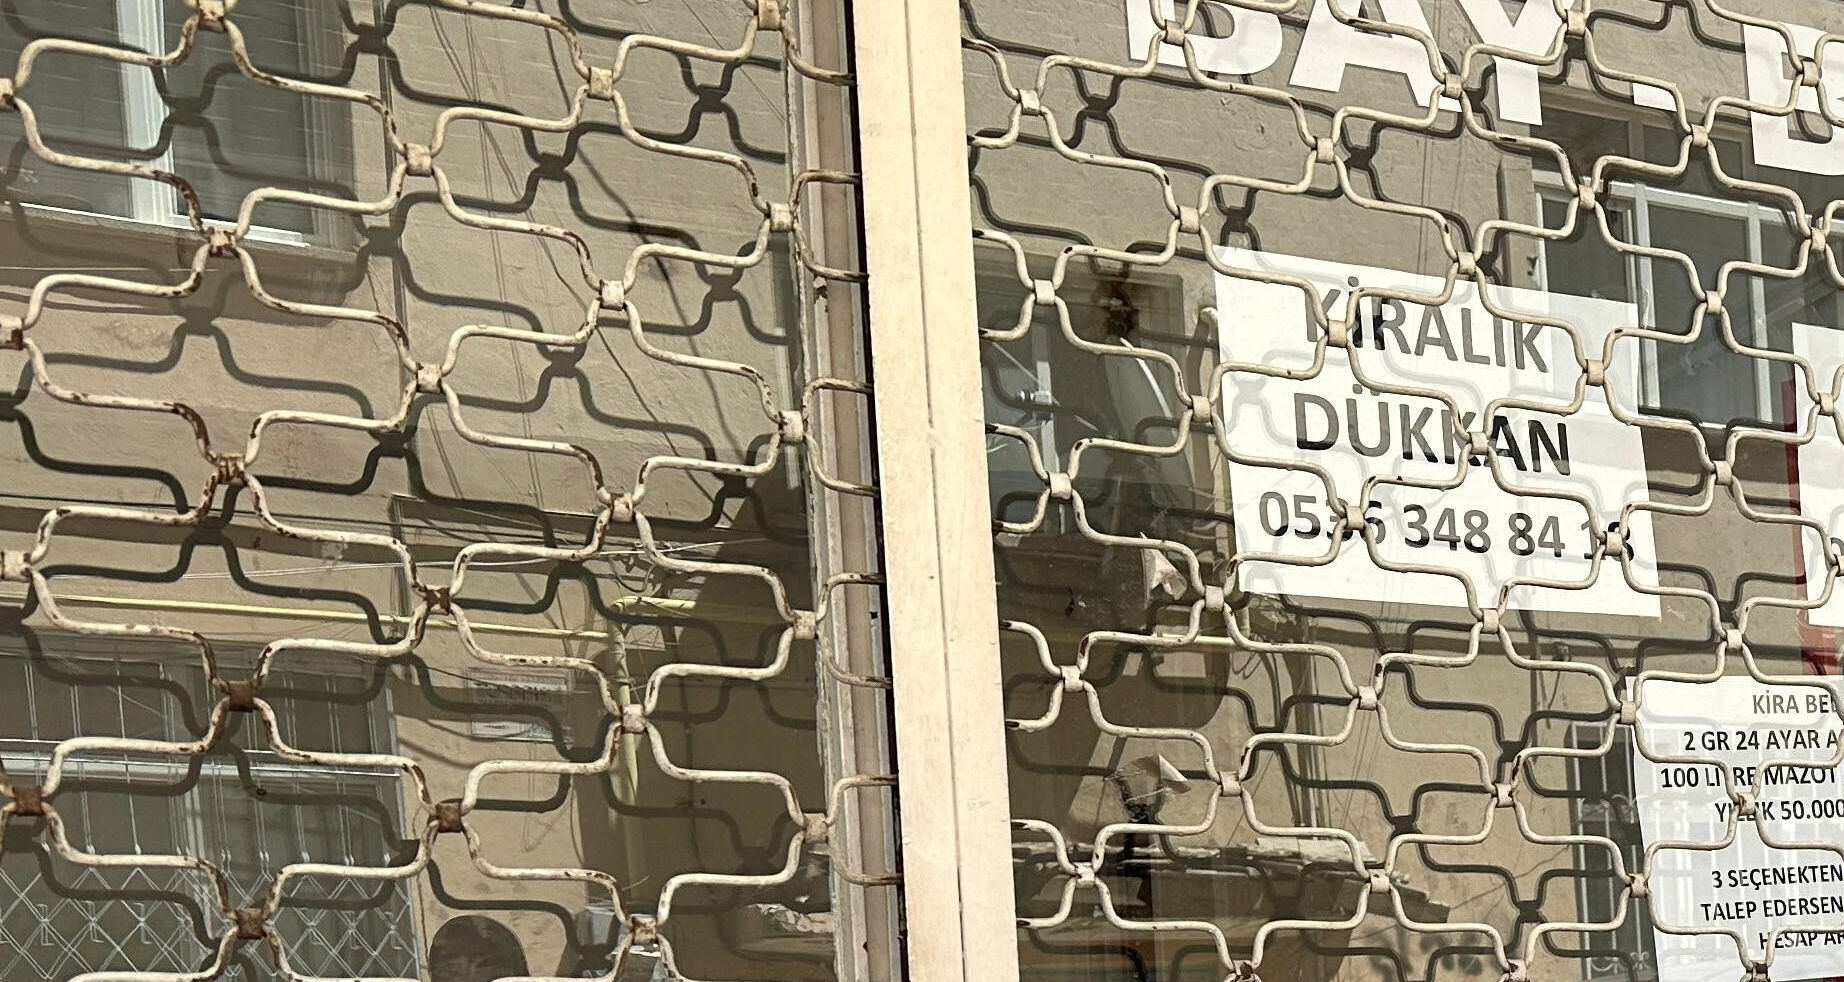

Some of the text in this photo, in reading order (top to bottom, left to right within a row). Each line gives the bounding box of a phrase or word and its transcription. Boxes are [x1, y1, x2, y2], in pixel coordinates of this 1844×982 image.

[1305, 276, 1549, 373] KİRALIK
[1294, 384, 1570, 475] DÜKKAN
[1404, 504, 1491, 553] 348
[1508, 513, 1566, 558] 84
[1753, 690, 1800, 714] KİRA
[1684, 731, 1696, 751] 2
[1702, 731, 1730, 751] GR
[1735, 731, 1760, 751] 24
[1766, 729, 1821, 750] AYAR
[1660, 767, 1699, 788] 100
[1711, 870, 1723, 889] 3
[1727, 864, 1844, 891] SEÇENEKTEN
[1700, 901, 1757, 921] TALEP
[1759, 931, 1818, 950] HESAP
